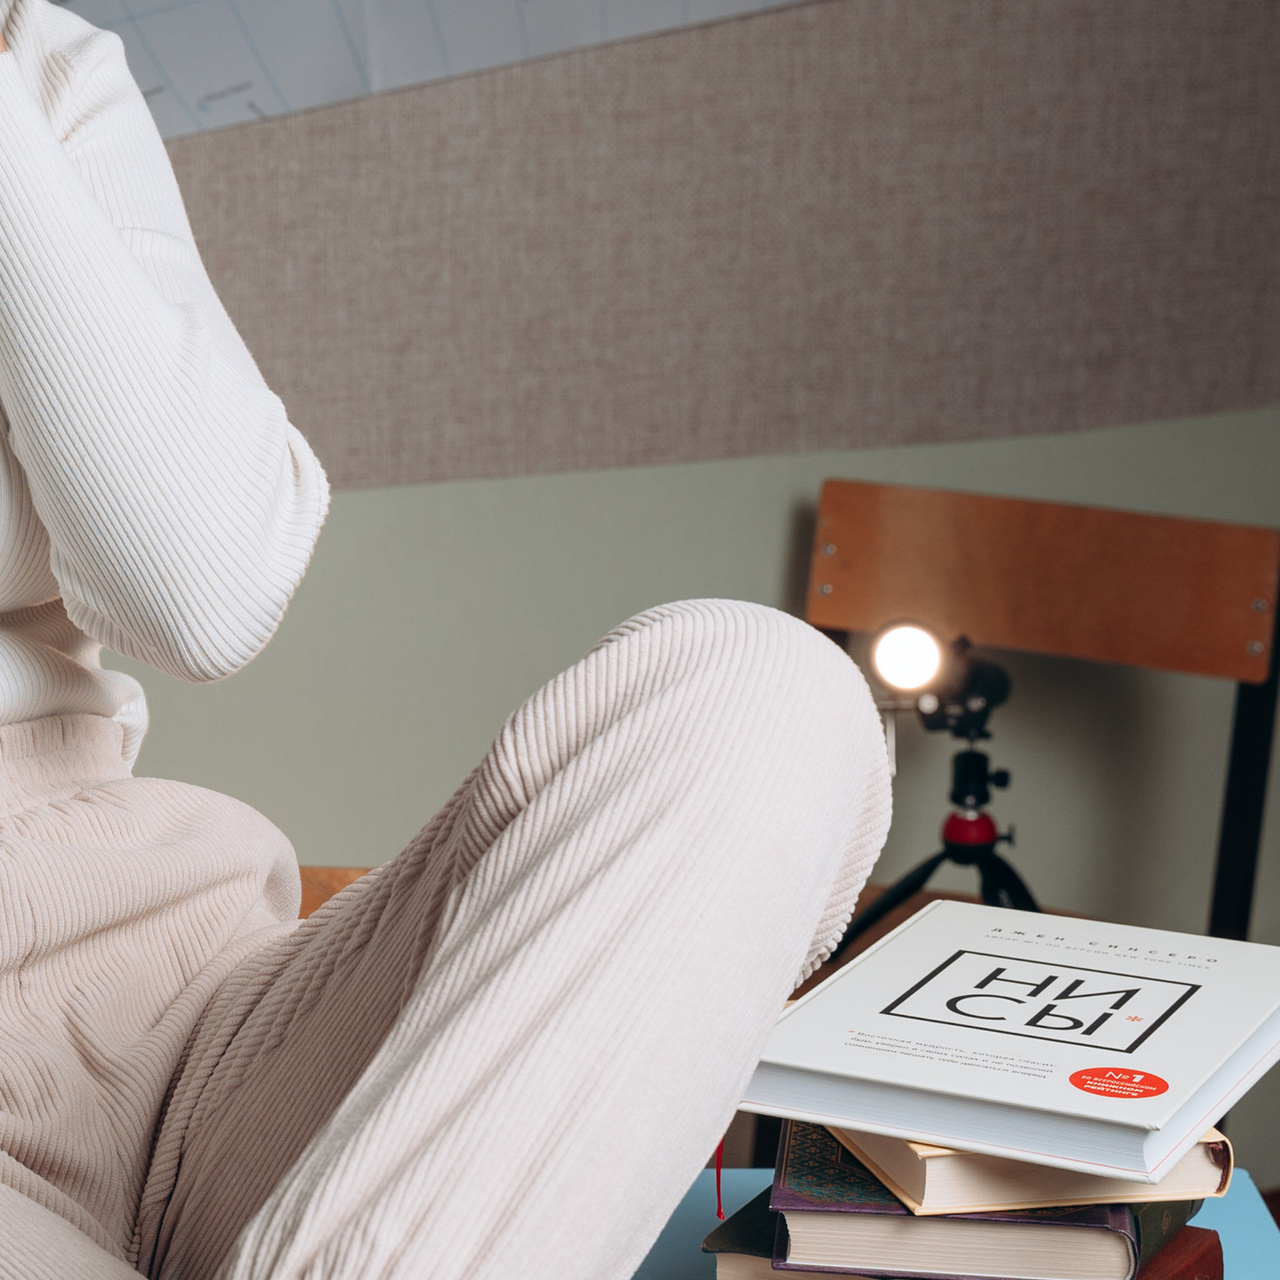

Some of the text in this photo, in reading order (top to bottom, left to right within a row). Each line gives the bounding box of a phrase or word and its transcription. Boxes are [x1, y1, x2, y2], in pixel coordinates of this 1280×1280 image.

[973, 967, 1142, 1011] НИ
[945, 993, 1114, 1037] СЫ
[1105, 1071, 1144, 1083] №1
[1084, 1084, 1139, 1097] РЕЙТИНГЕ
[1086, 1080, 1144, 1093] КНИЖНОМ
